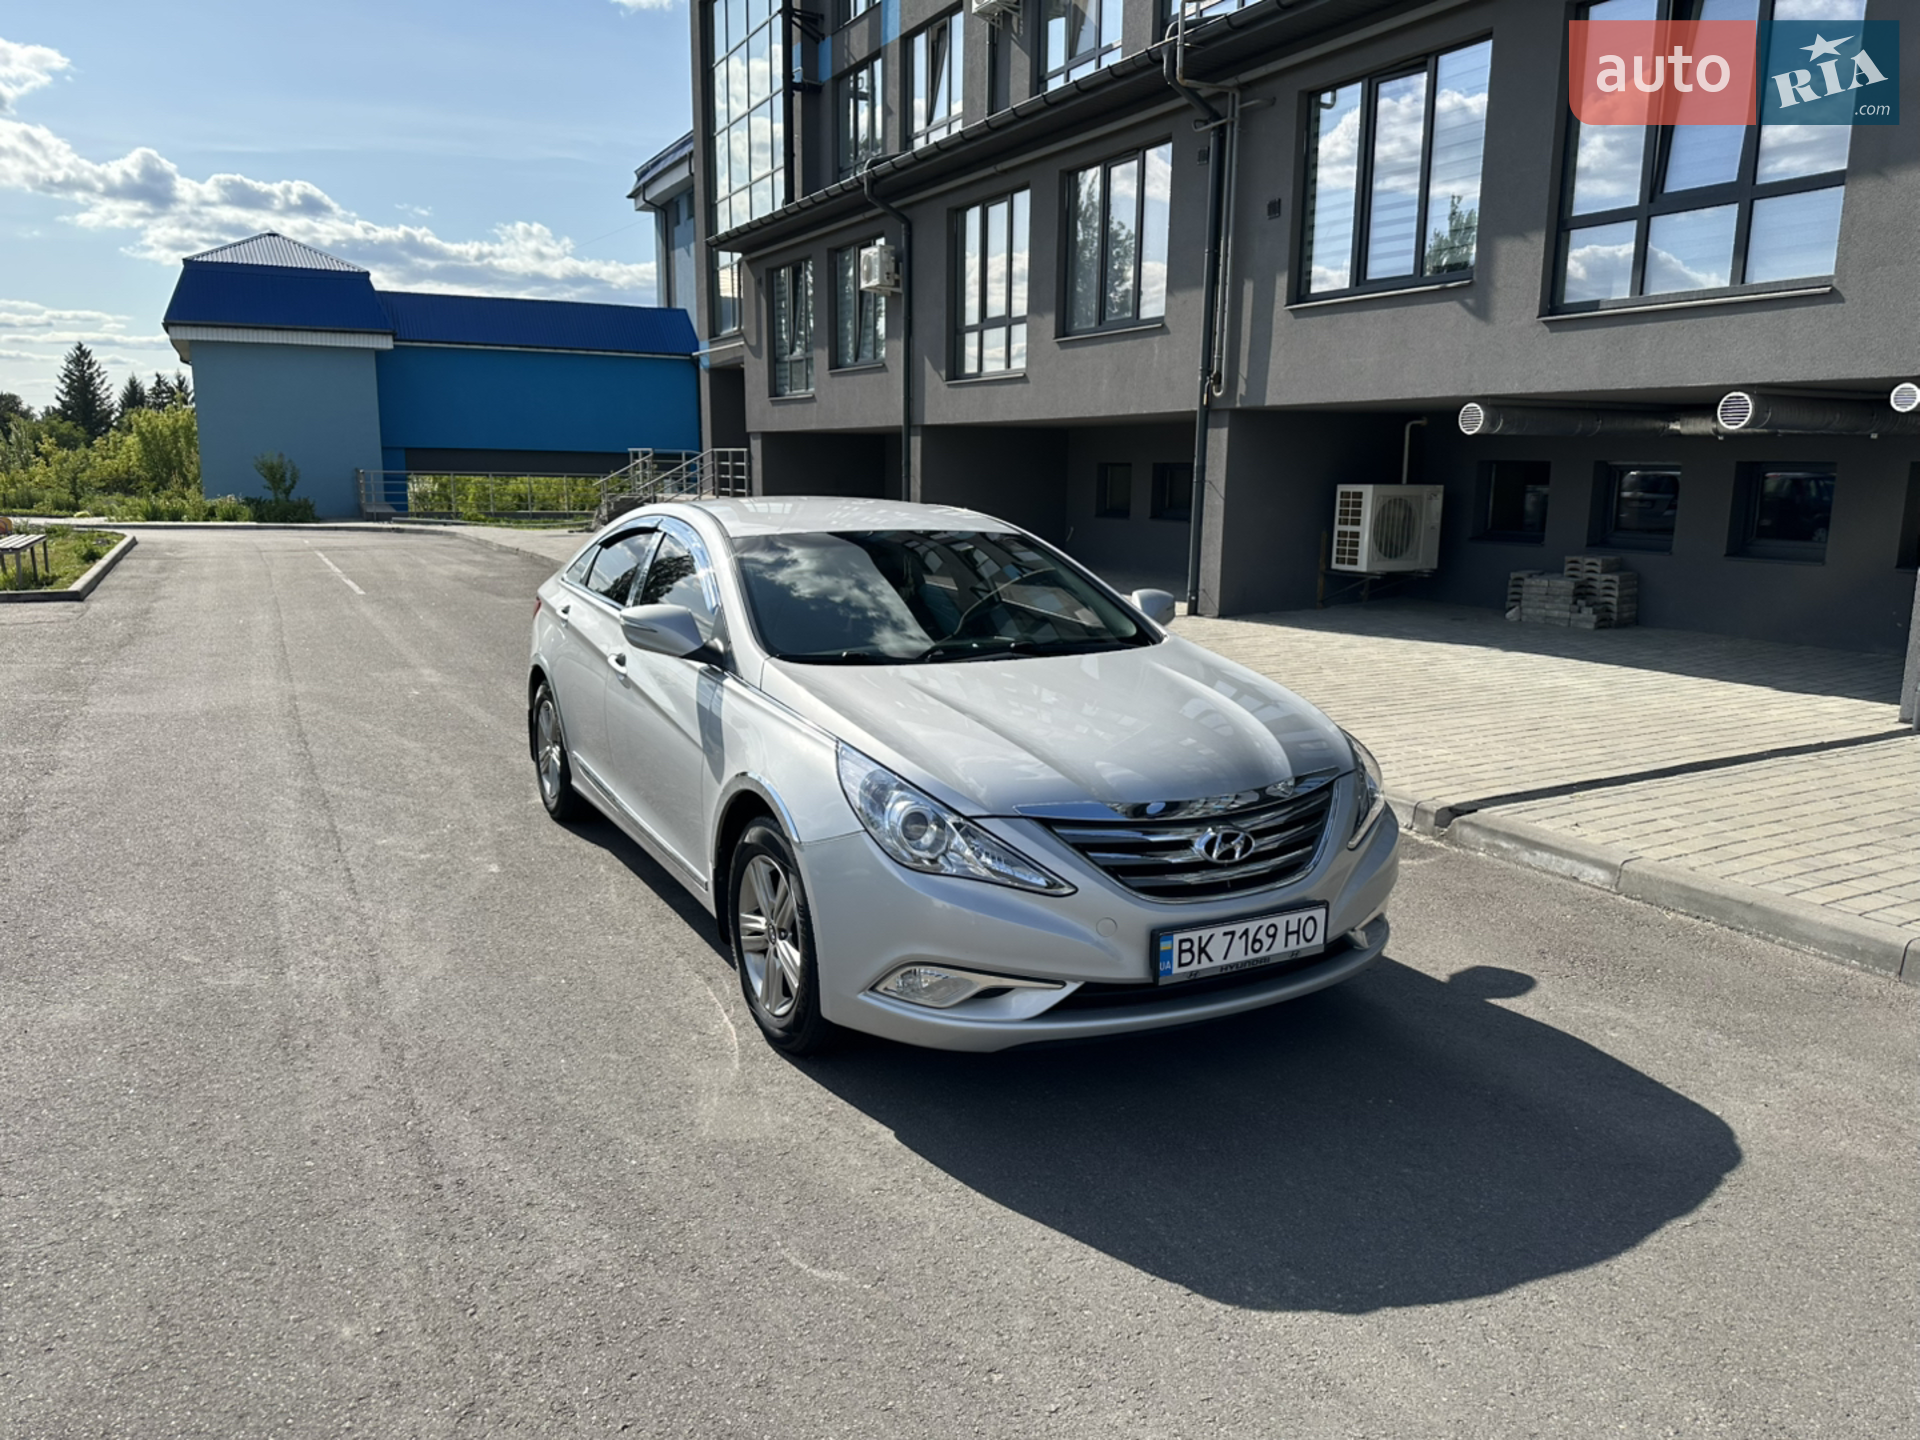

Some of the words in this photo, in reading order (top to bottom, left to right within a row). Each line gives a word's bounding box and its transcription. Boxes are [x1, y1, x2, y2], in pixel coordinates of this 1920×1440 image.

[1177, 932, 1215, 968] BK
[1222, 923, 1278, 961] 7169
[1284, 915, 1318, 948] HO
[1159, 961, 1172, 971] UA
[1219, 956, 1271, 973] HYUNDAI
